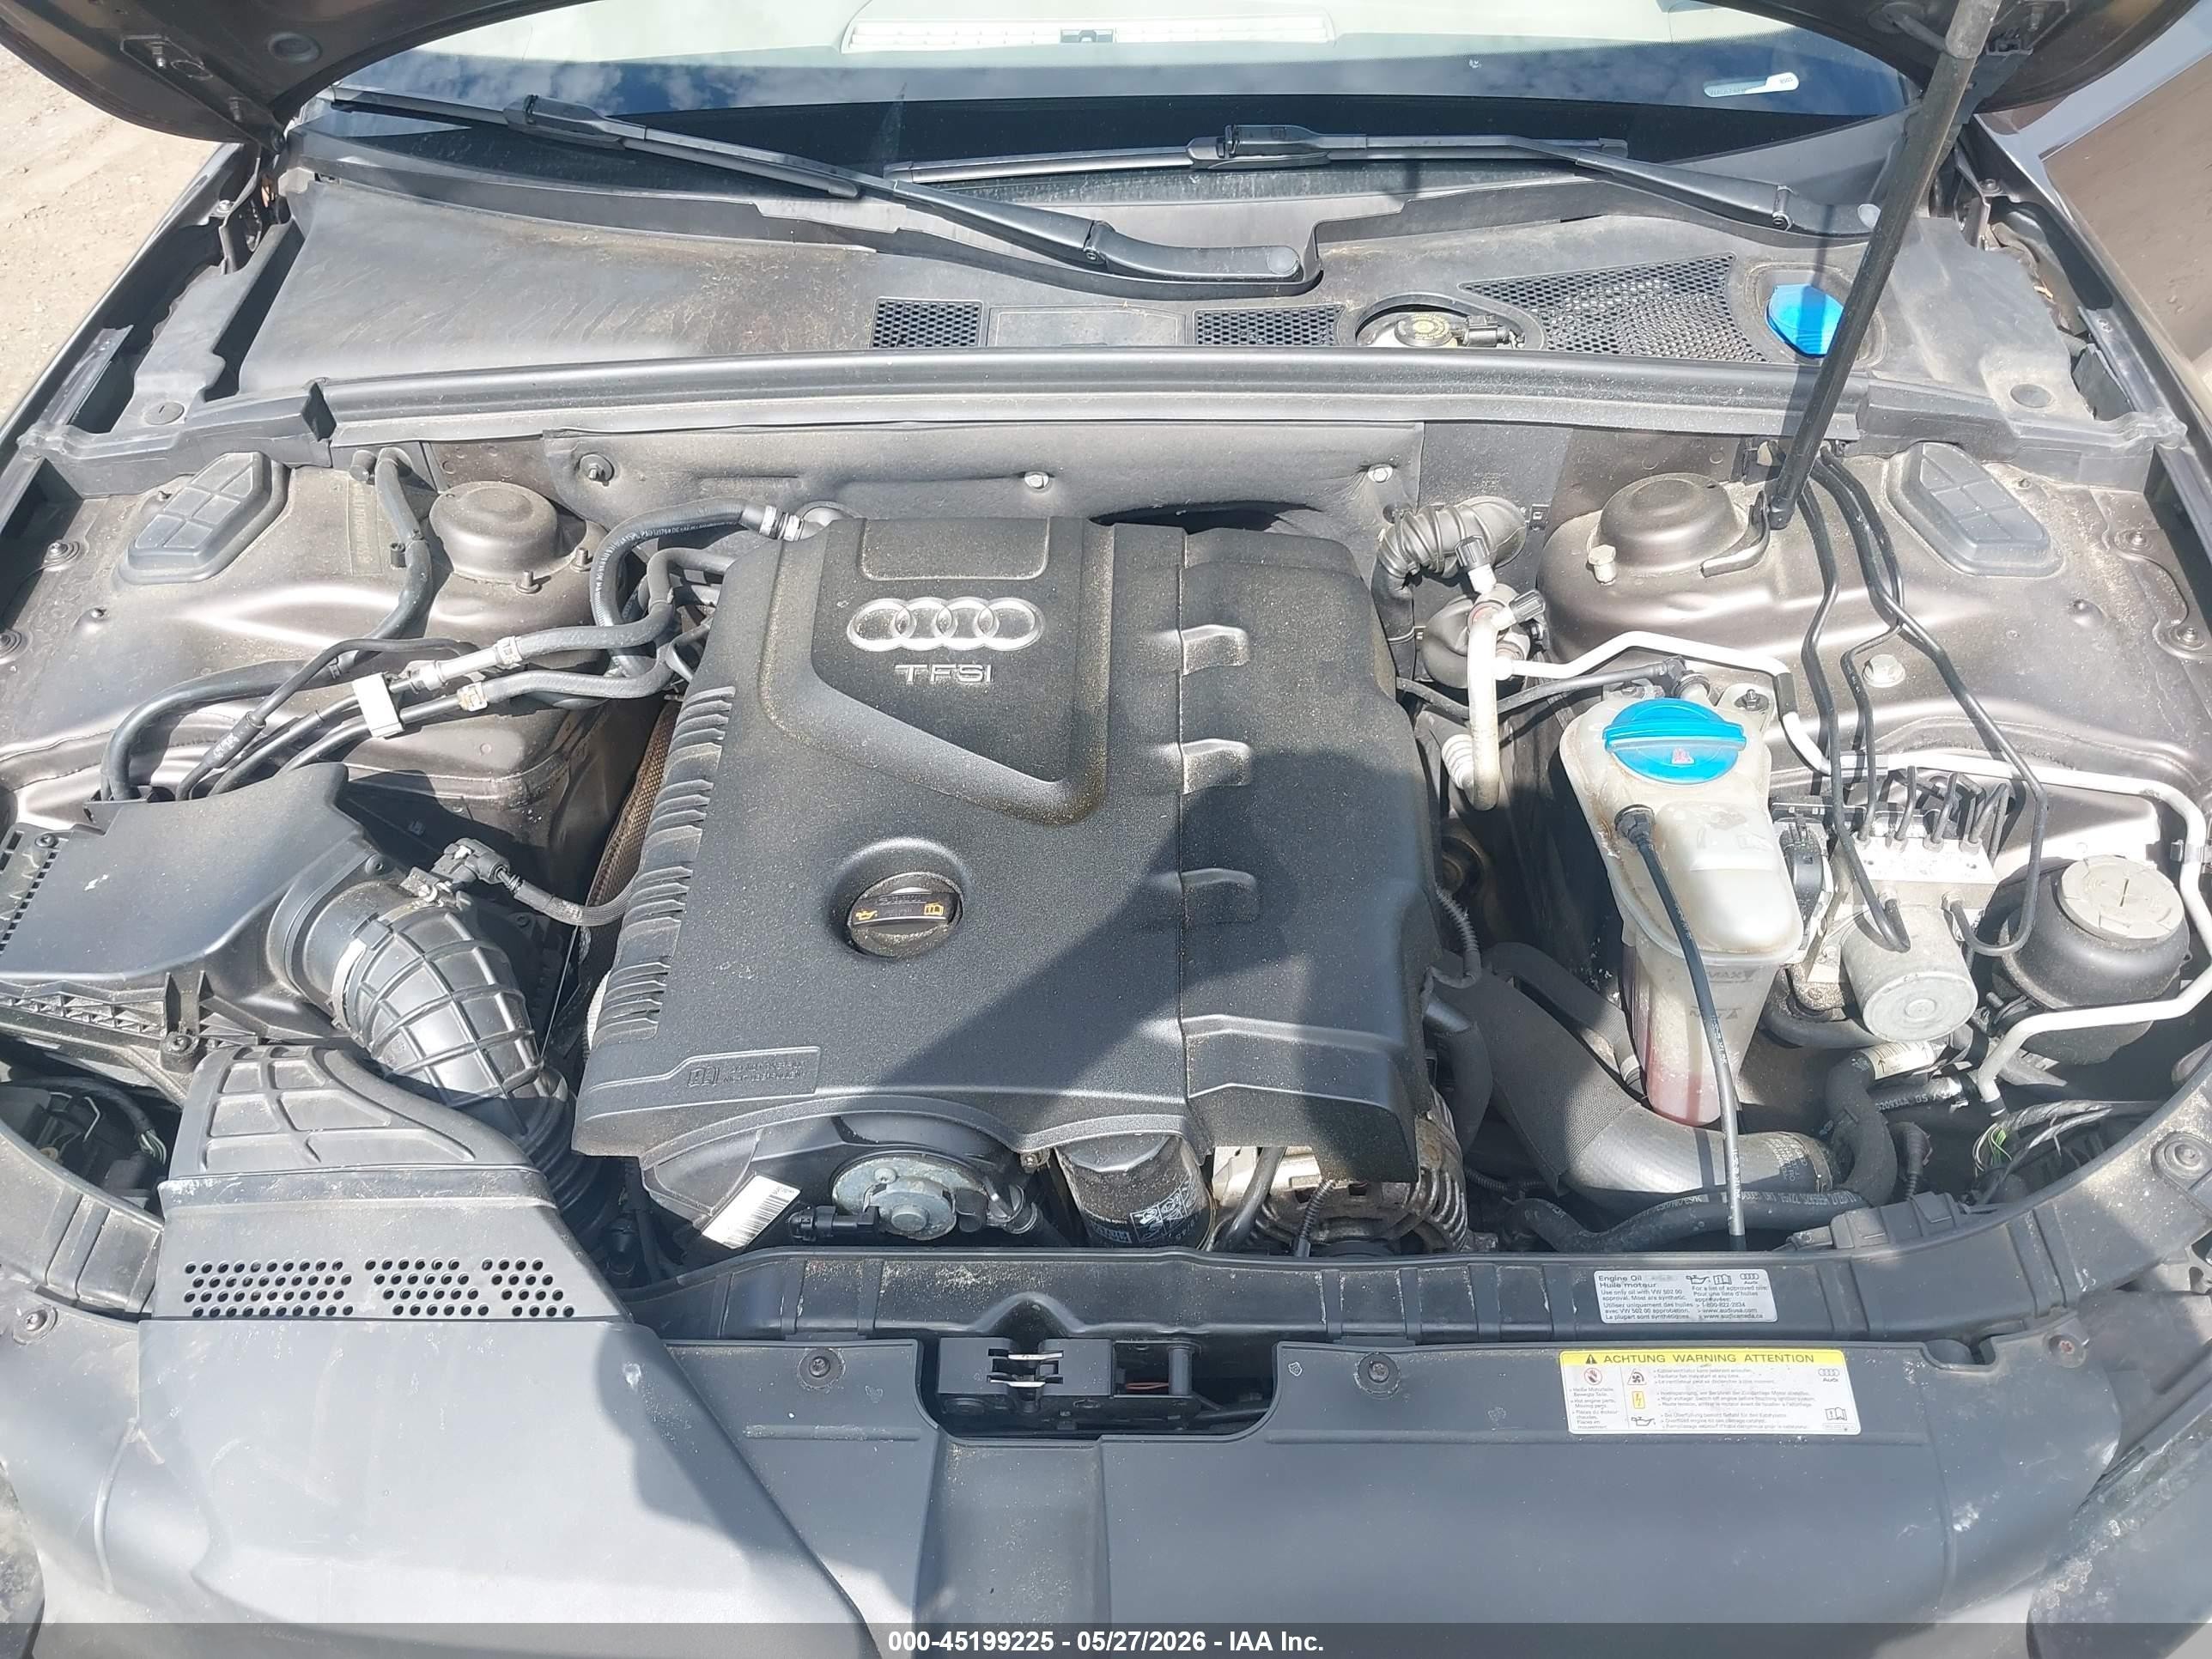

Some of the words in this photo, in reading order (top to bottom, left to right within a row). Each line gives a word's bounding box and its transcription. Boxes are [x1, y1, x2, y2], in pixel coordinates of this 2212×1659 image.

[894, 662, 993, 684] TFSI
[1604, 1354, 1666, 1364] ACHTUNG
[1673, 1353, 1736, 1364] WARNING
[1744, 1353, 1814, 1364] ATTENTION
